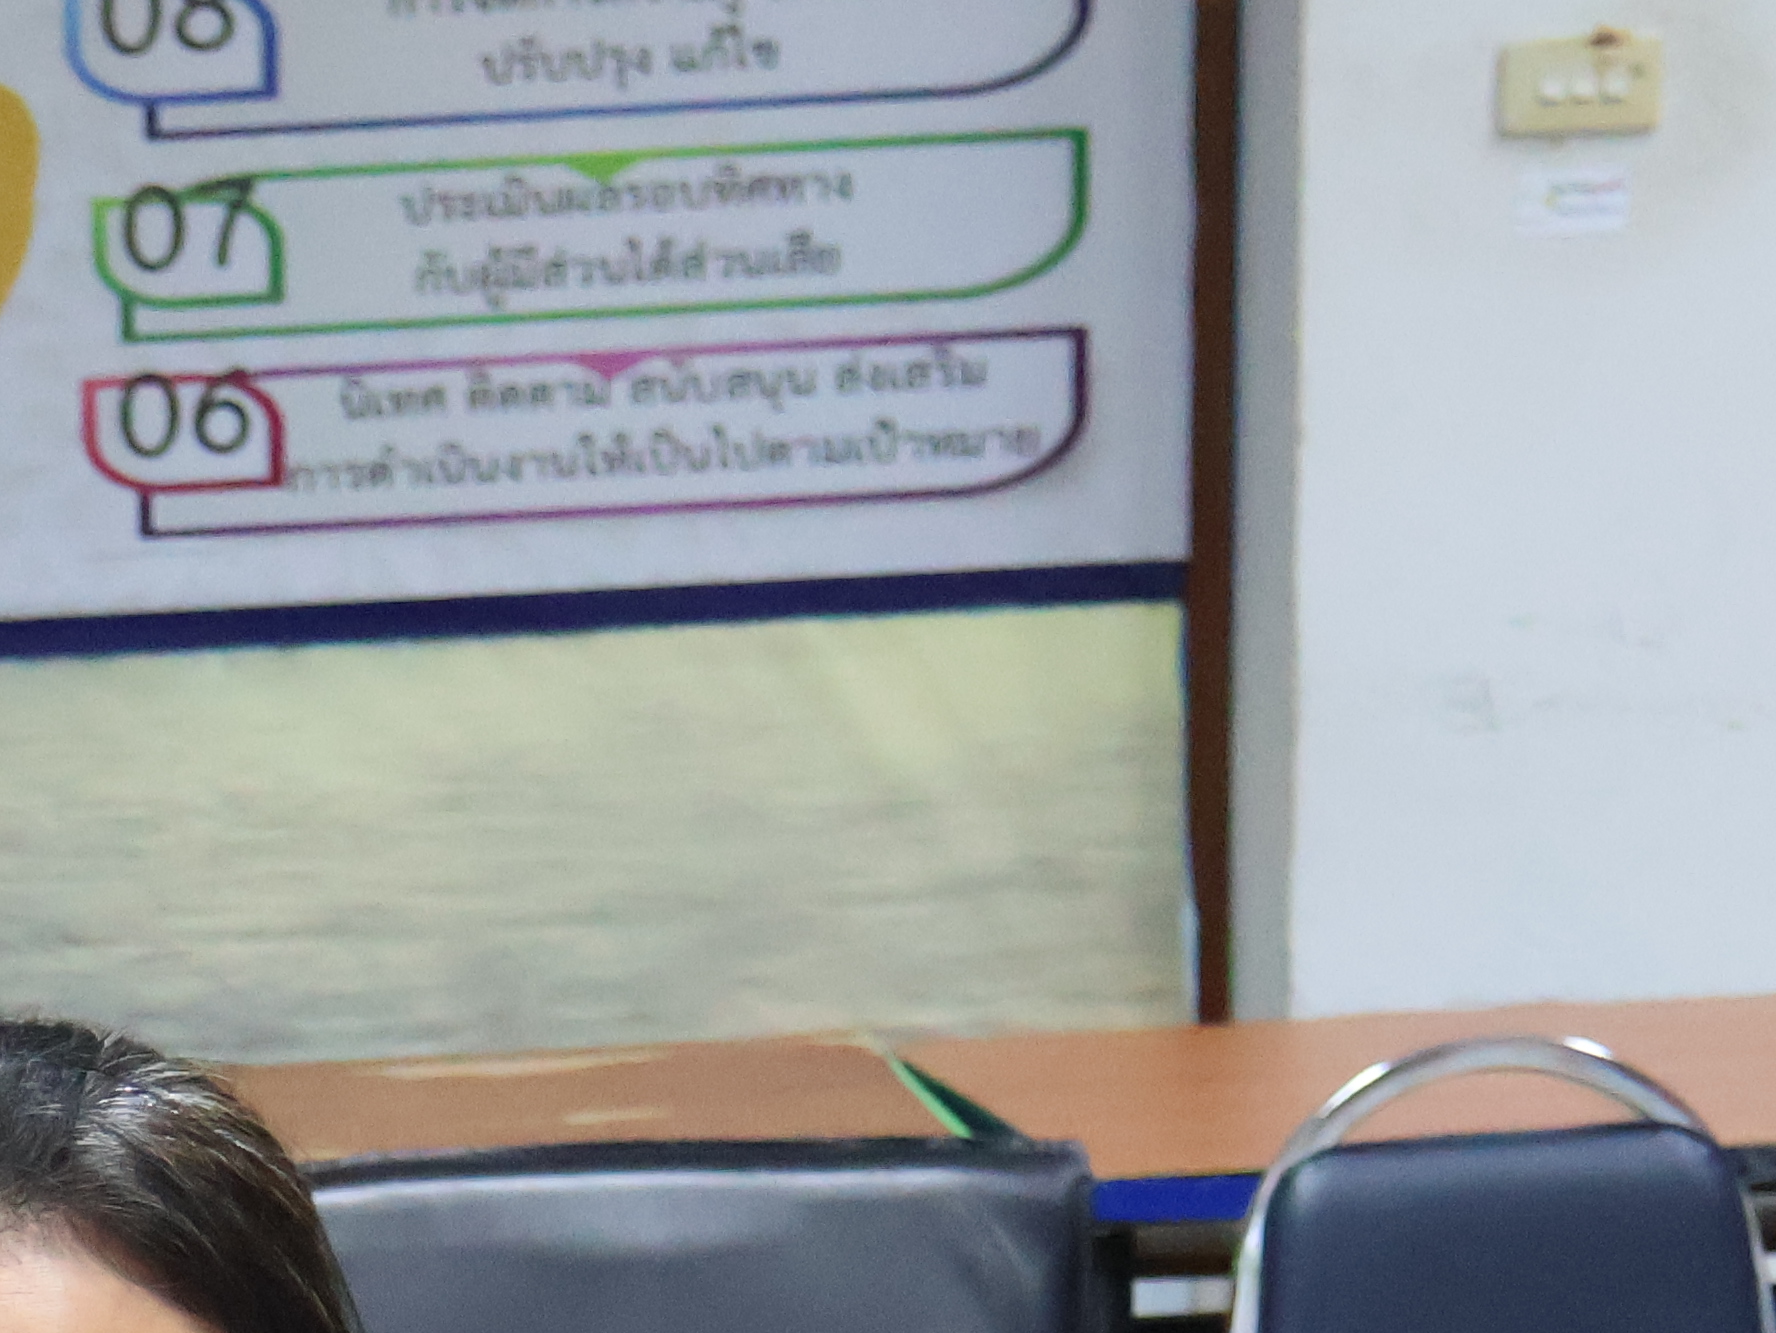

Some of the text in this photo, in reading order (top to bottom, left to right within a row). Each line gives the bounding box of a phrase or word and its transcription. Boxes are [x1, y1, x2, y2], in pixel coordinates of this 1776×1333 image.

[103, 0, 235, 55] 08
[125, 177, 255, 271] 07
[120, 368, 252, 458] 06
